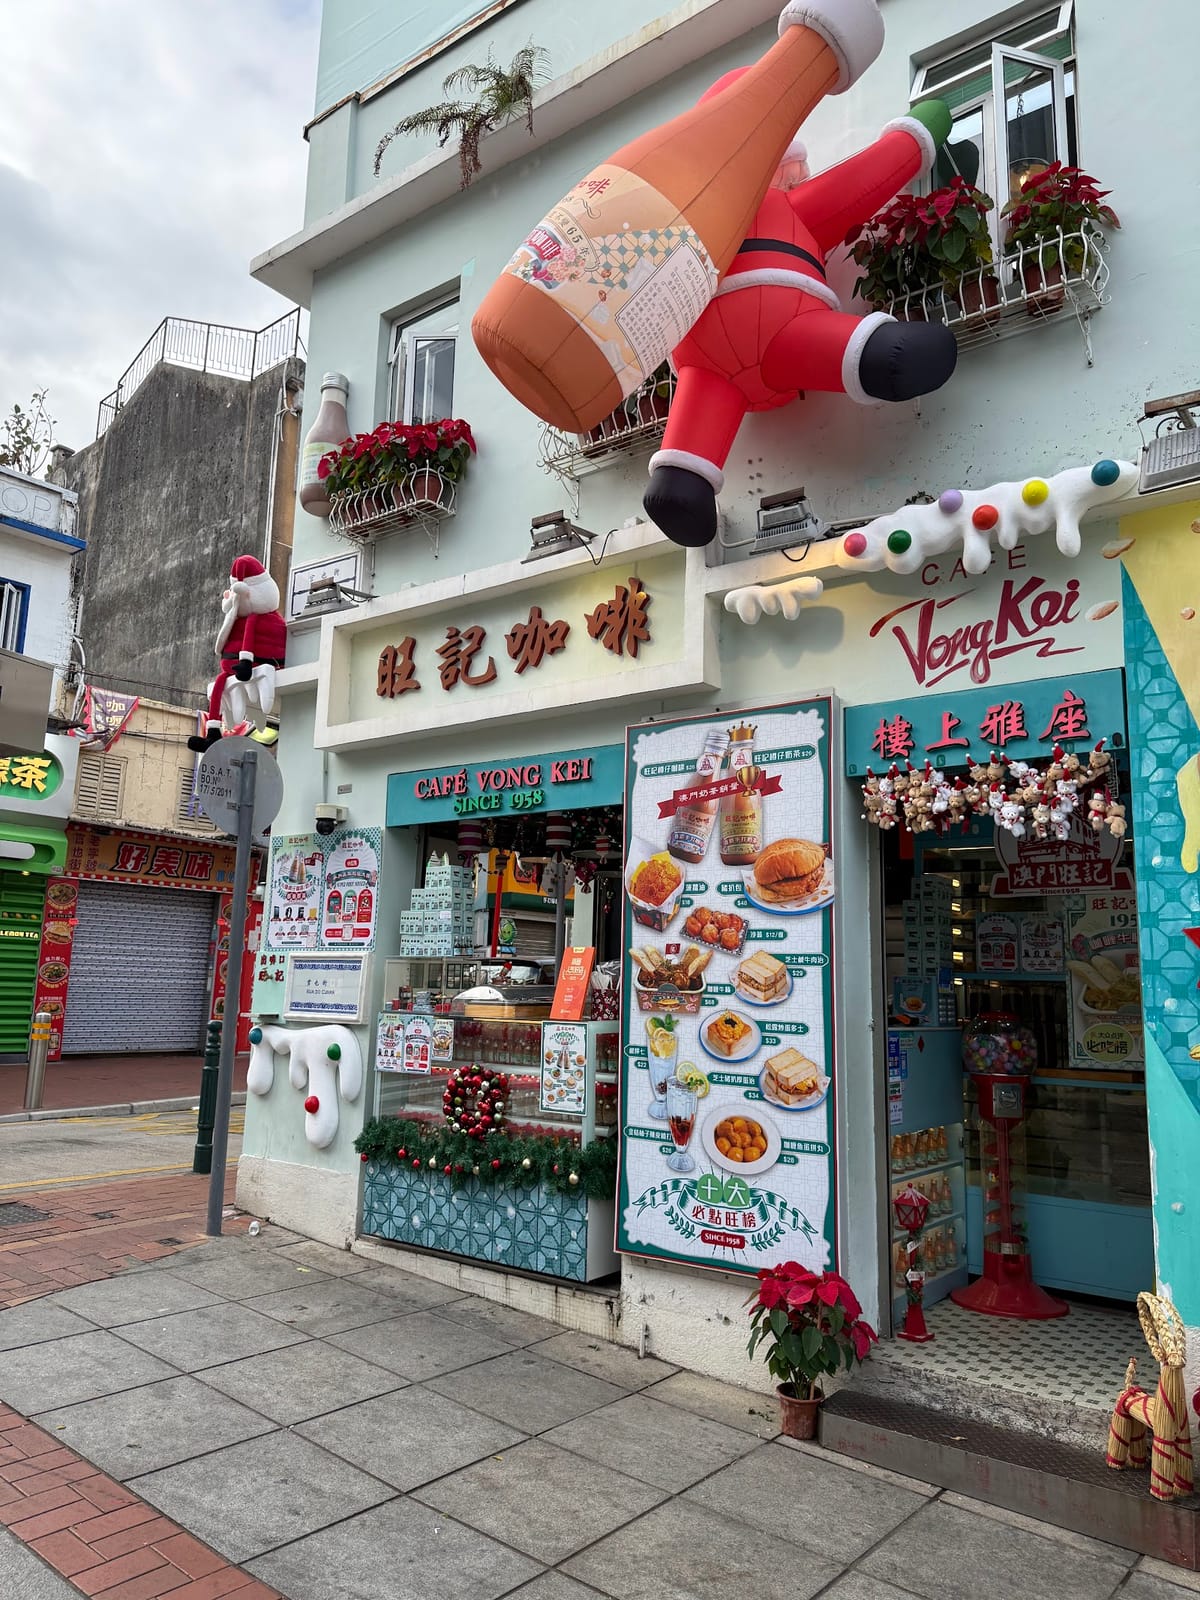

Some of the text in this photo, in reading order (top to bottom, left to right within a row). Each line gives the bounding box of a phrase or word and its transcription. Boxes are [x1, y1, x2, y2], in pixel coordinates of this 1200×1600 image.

[921, 545, 1027, 586] CAE
[376, 577, 651, 698] 旺記咖啡
[870, 576, 1081, 686] Vong Kei
[871, 689, 1092, 760] 樓上雅座
[414, 758, 593, 799] CAFÉ VONG KEI
[453, 789, 545, 815] SINCE 1958
[113, 842, 215, 881] 好美味
[1013, 862, 1108, 886] 澳門旺記
[691, 1205, 757, 1228] 必點旺榜
[704, 1231, 741, 1246] SINCE 1958
